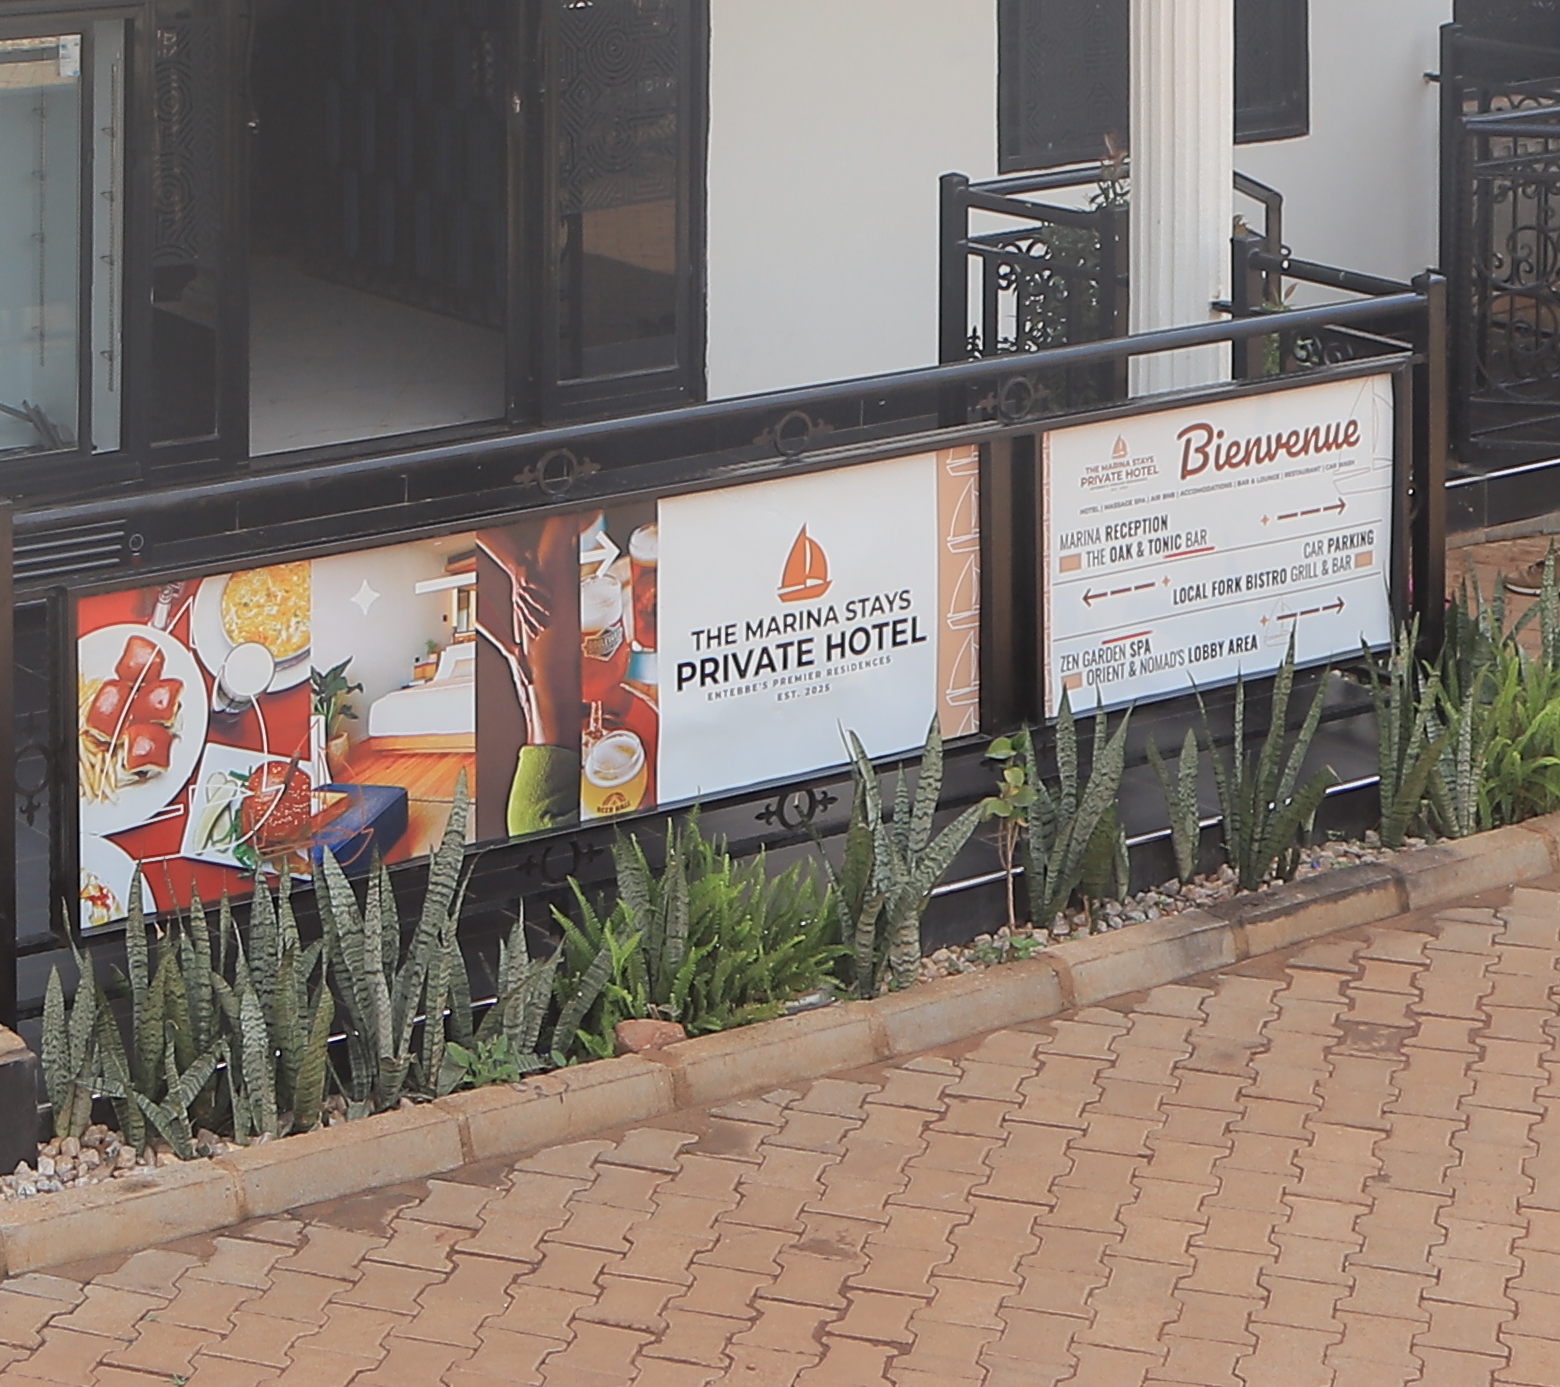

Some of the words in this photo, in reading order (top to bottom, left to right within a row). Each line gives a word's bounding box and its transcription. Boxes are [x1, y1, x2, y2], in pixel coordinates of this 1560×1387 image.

[1176, 419, 1361, 480] Bienvenue
[1080, 470, 1123, 488] PRIVATE
[1125, 465, 1159, 480] HOTEL
[1059, 527, 1101, 551] MARINA
[1105, 514, 1168, 541] RECEPTION
[1086, 549, 1106, 567] THE
[1110, 543, 1134, 563] OAK
[1136, 541, 1144, 558] &
[1148, 534, 1182, 555] TONIC
[1186, 529, 1207, 548] BAR
[1304, 540, 1324, 558] CAR
[1327, 529, 1374, 554] PARKING
[1173, 584, 1208, 605] LOCAL
[1211, 576, 1242, 597] FORK
[1246, 568, 1287, 591] BISTRO
[1290, 562, 1319, 582] GRILL
[1321, 560, 1329, 576] &
[1332, 554, 1352, 573] BAR
[691, 623, 738, 651] THE
[745, 605, 839, 641] MARINA
[845, 589, 911, 621] STAYS
[676, 637, 815, 692] PRIVATE
[826, 615, 927, 662] HOTEL
[1060, 654, 1079, 673] ZEN
[1082, 644, 1126, 668] GARDEN
[1130, 639, 1151, 658] SPA
[1086, 664, 1125, 686] ORIENT
[1128, 660, 1137, 677] &
[1140, 649, 1185, 675] NOMAD'S
[1188, 643, 1225, 663] LOBBY
[1228, 635, 1258, 655] AREA
[707, 681, 768, 701] ENTEBBE'S
[773, 670, 822, 688] PREMIER
[826, 655, 892, 677] RESIDENCES
[777, 690, 800, 702] EST.
[805, 684, 830, 696] 2025
